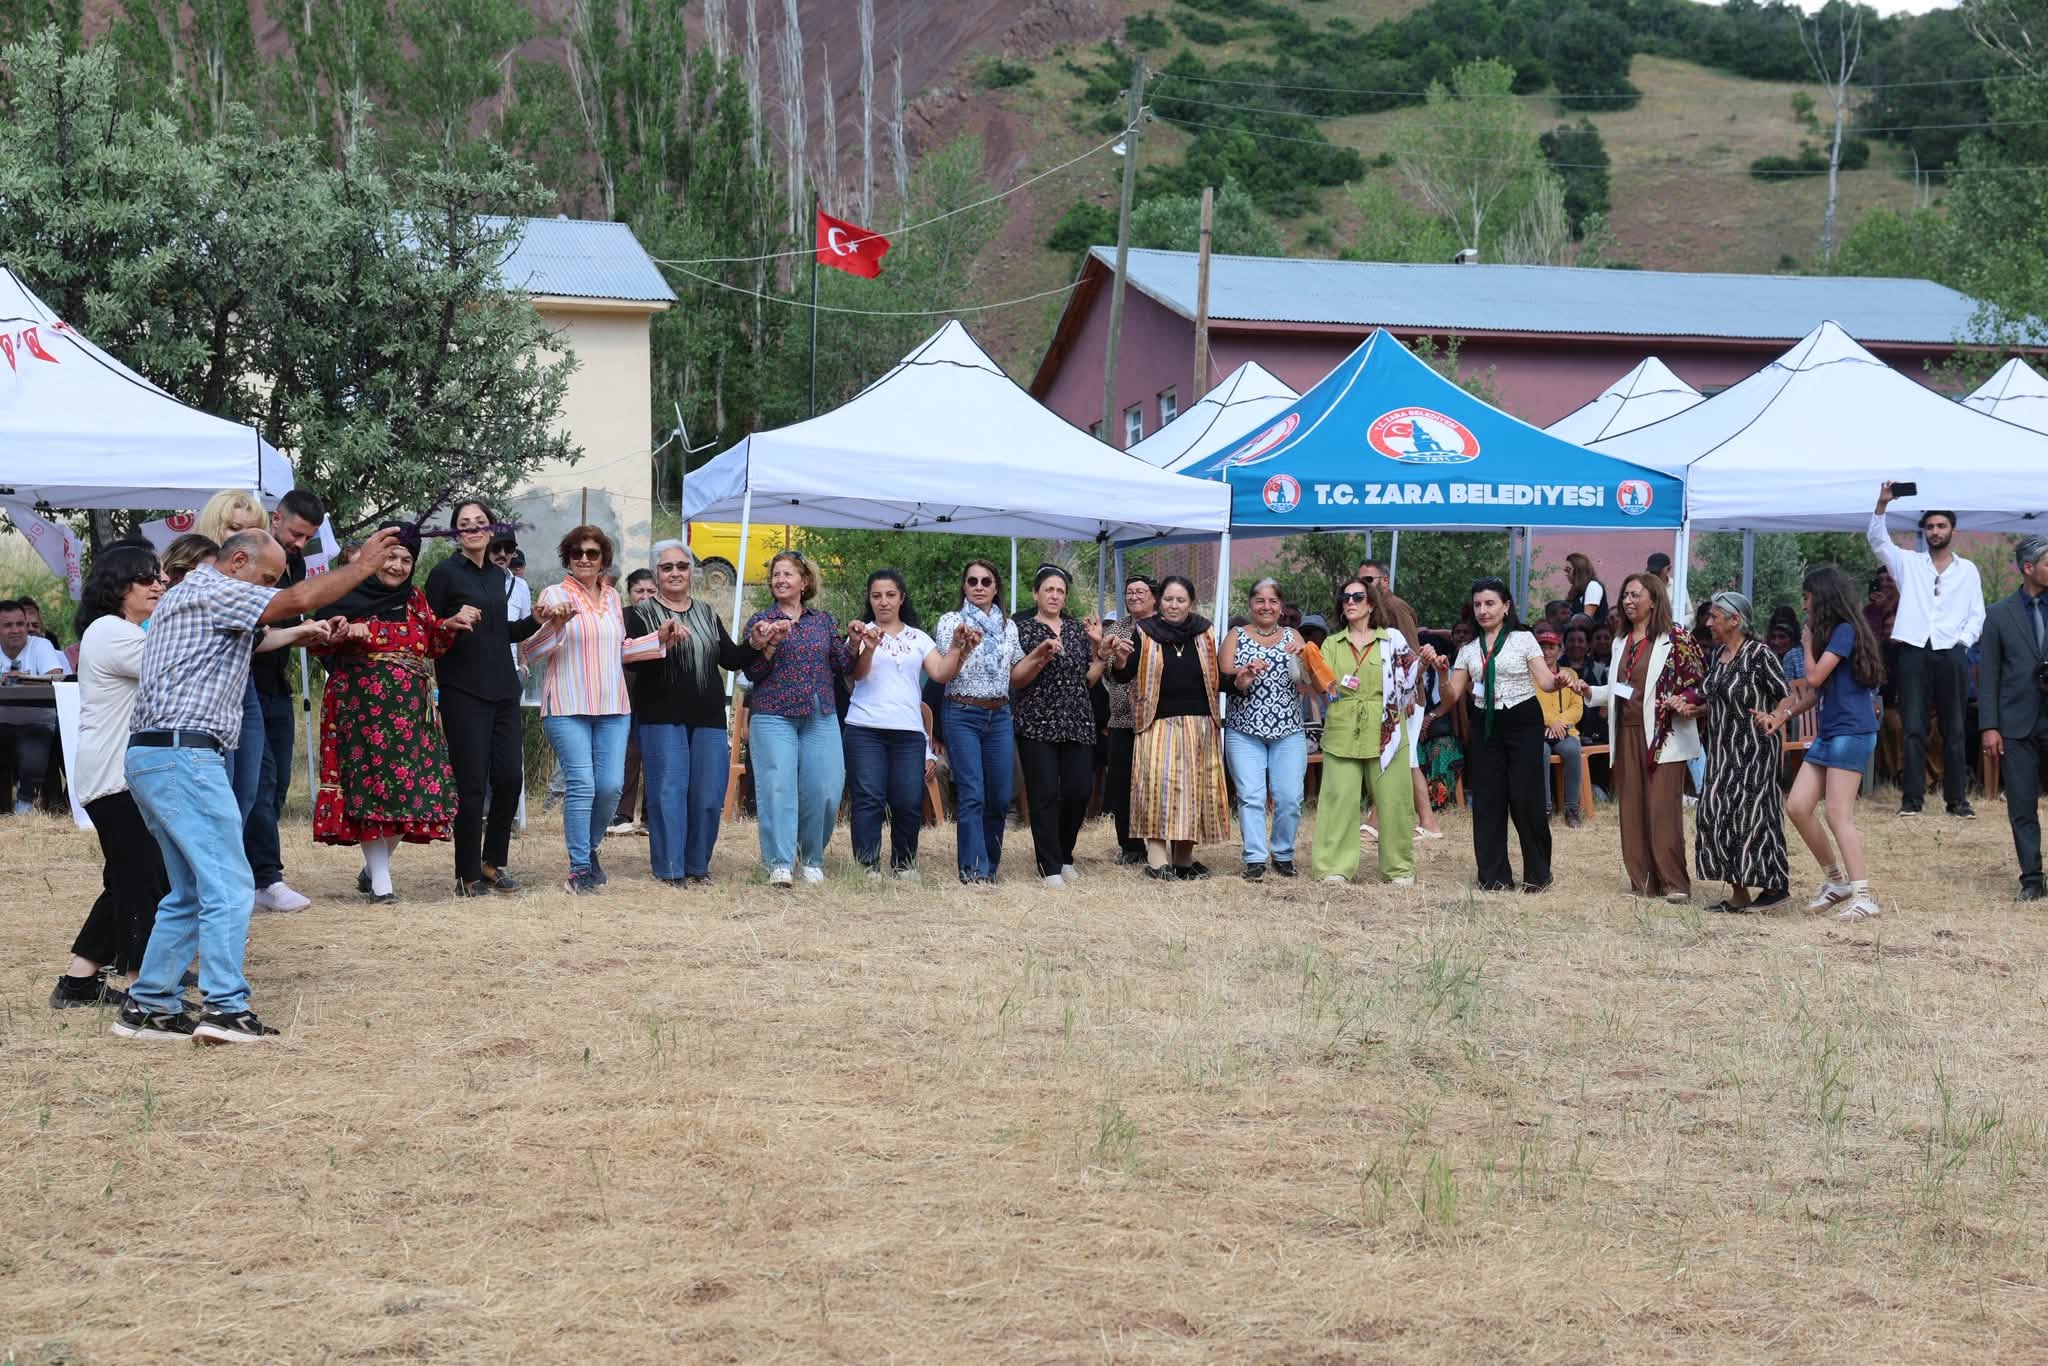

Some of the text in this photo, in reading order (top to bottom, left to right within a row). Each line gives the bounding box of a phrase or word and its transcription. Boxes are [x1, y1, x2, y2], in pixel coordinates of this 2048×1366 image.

[1314, 484, 1604, 507] T.C. ZARA BELEDİYESİ
